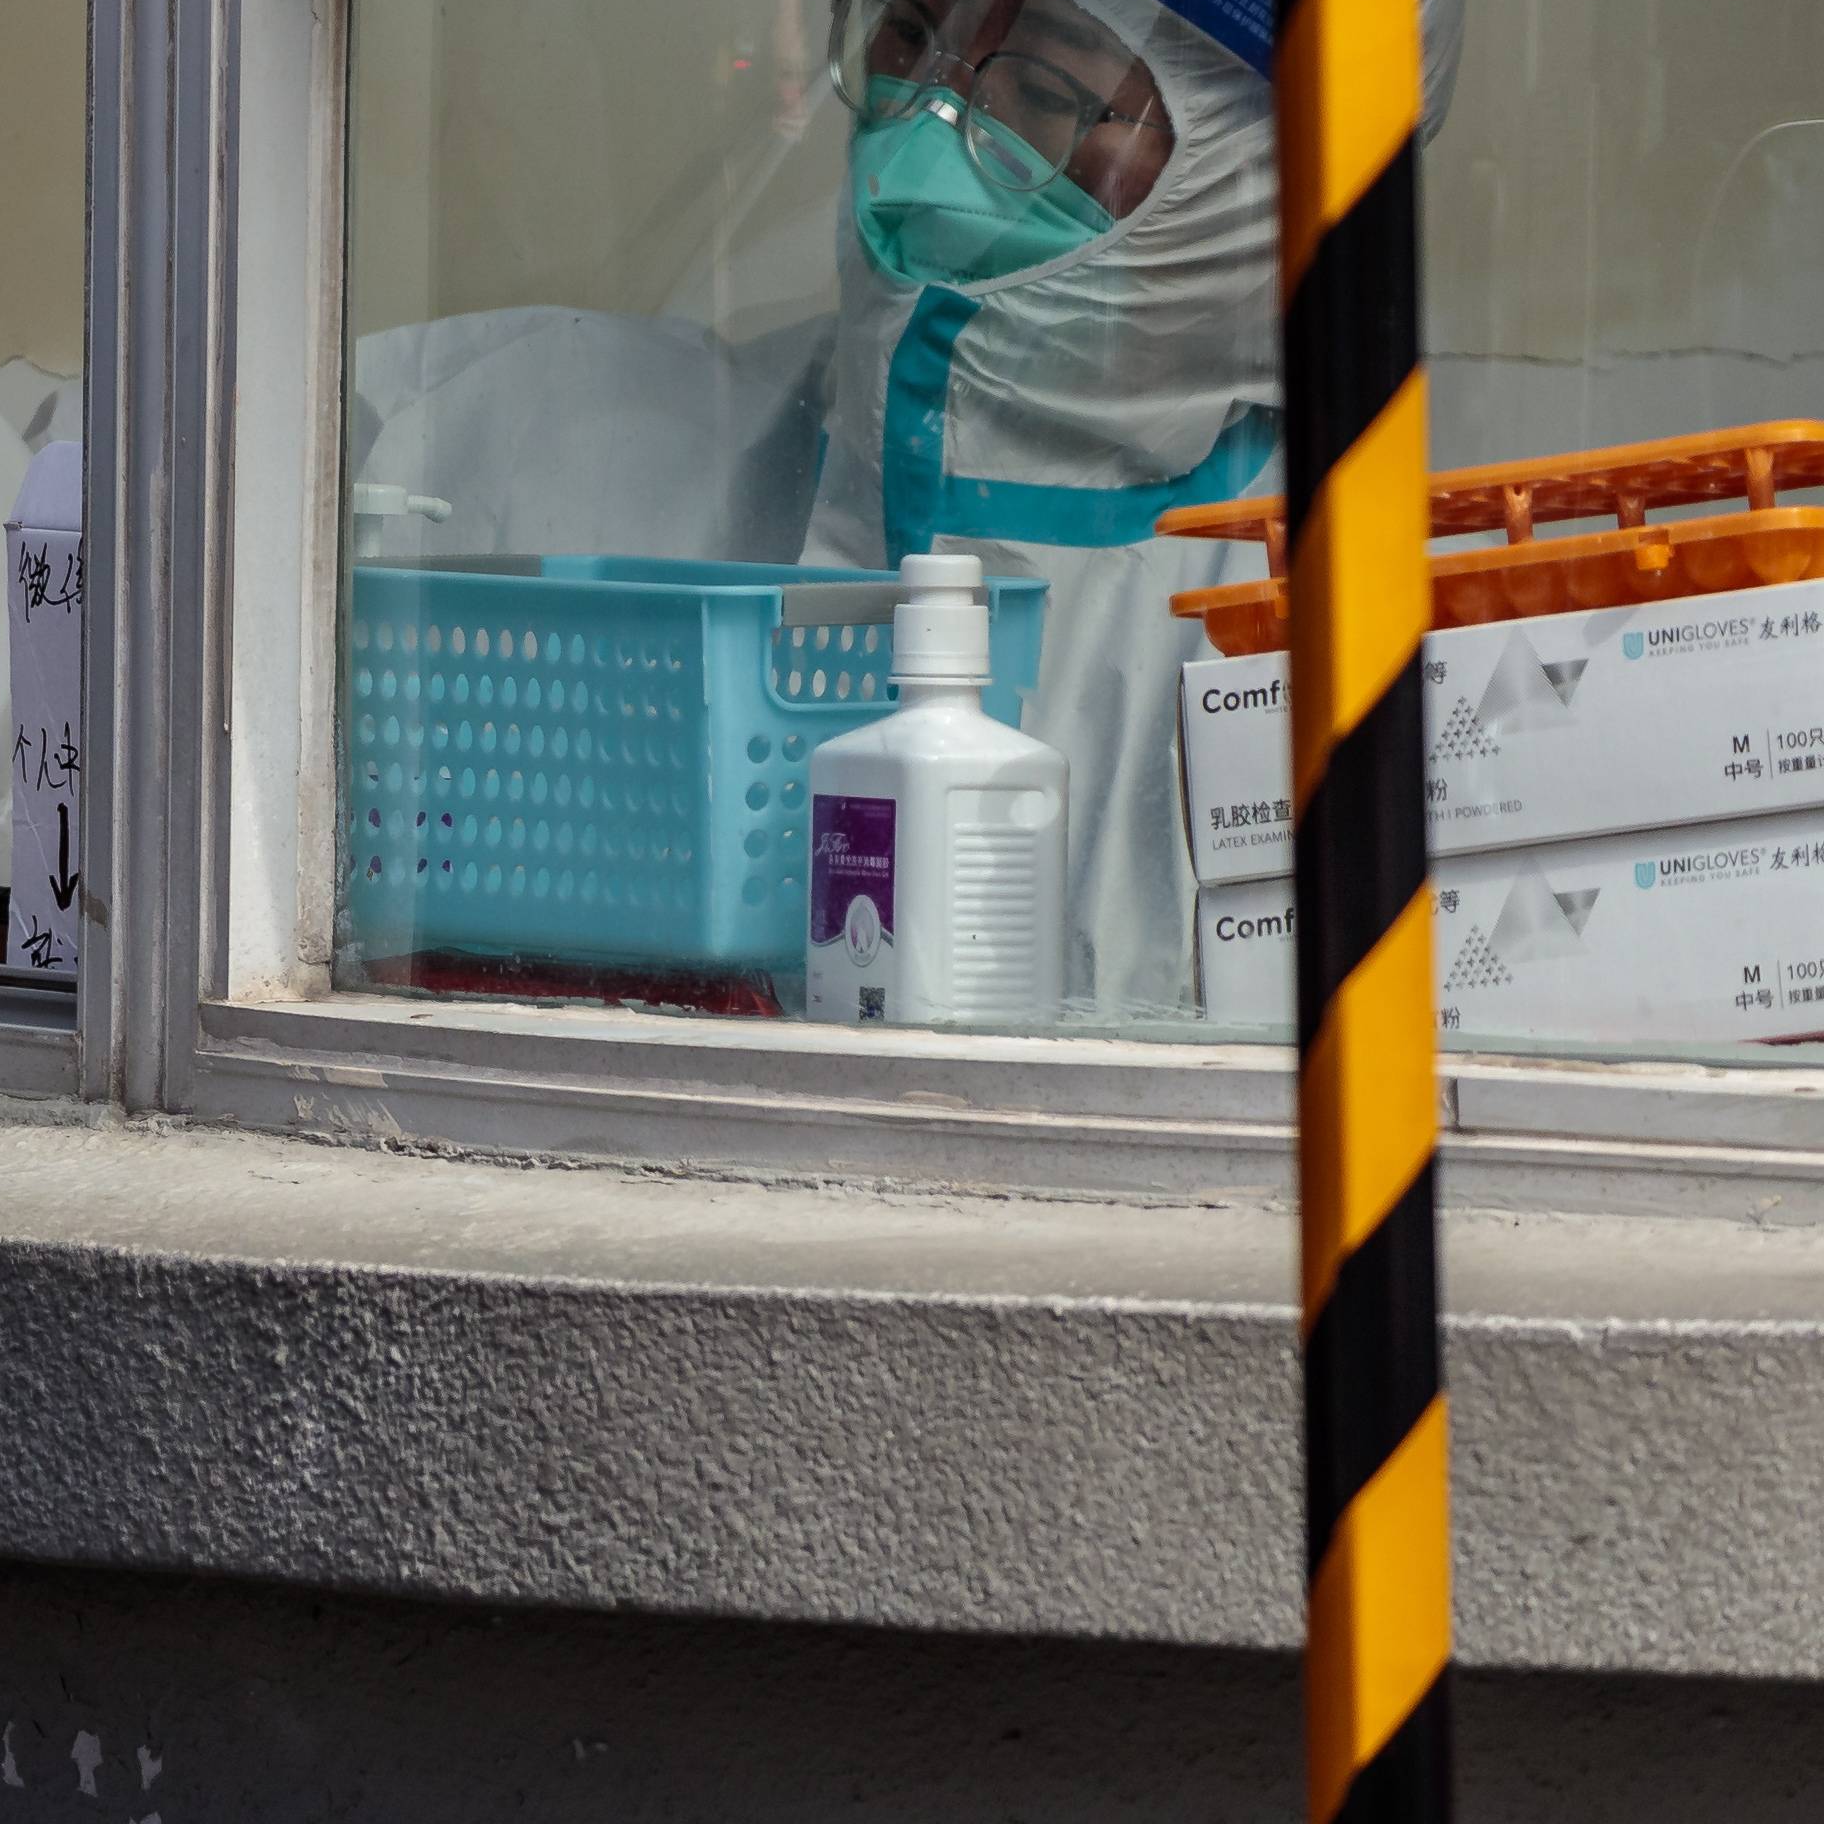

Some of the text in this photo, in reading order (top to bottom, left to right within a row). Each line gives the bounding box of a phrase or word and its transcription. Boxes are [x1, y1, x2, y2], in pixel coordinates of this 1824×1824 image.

[1732, 734, 1750, 754] M
[1724, 759, 1764, 782] 中号
[1213, 835, 1248, 851] LATEX
[1744, 963, 1761, 984] M
